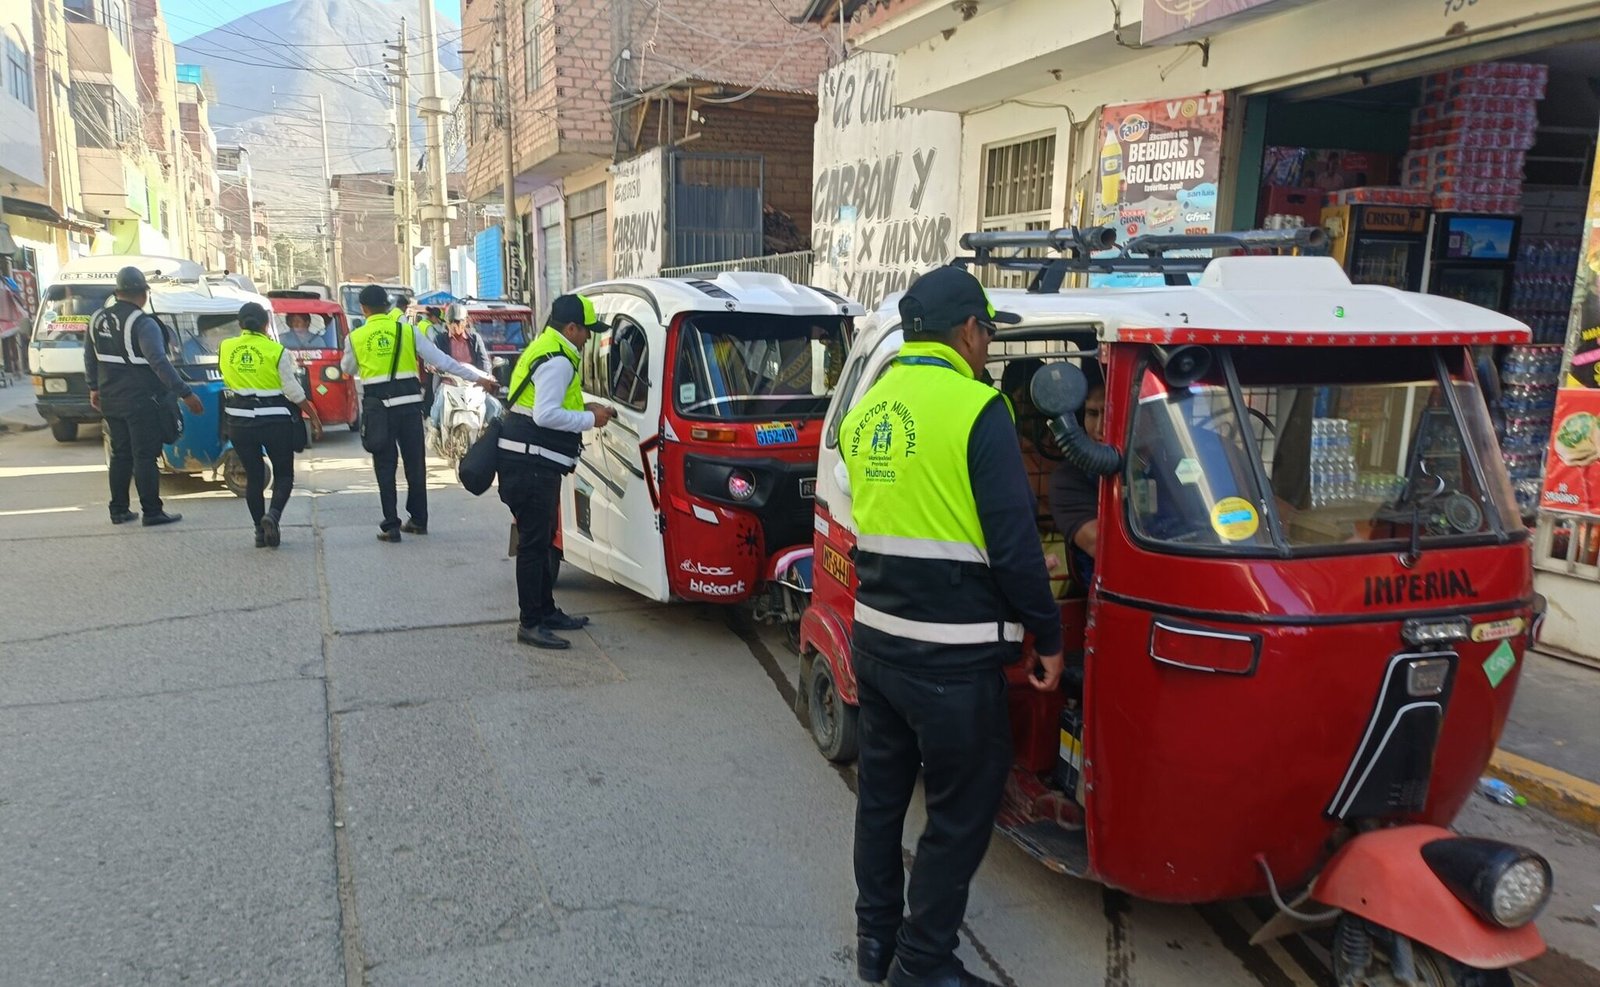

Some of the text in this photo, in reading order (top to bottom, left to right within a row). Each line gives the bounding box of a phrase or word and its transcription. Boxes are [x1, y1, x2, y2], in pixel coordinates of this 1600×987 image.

[1119, 120, 1149, 140] Fanta
[1129, 136, 1203, 162] BEBIDAS Y
[909, 147, 936, 216] Y
[1127, 159, 1205, 184] GOLOSINAS
[650, 209, 660, 253] Y
[1367, 211, 1407, 225] CRISTAL
[857, 226, 875, 262] X
[880, 217, 951, 265] MAYOR
[636, 251, 644, 273] X
[851, 401, 916, 458] INSPECTOR MUNICIPAL
[1364, 568, 1478, 607] IMPERIAL
